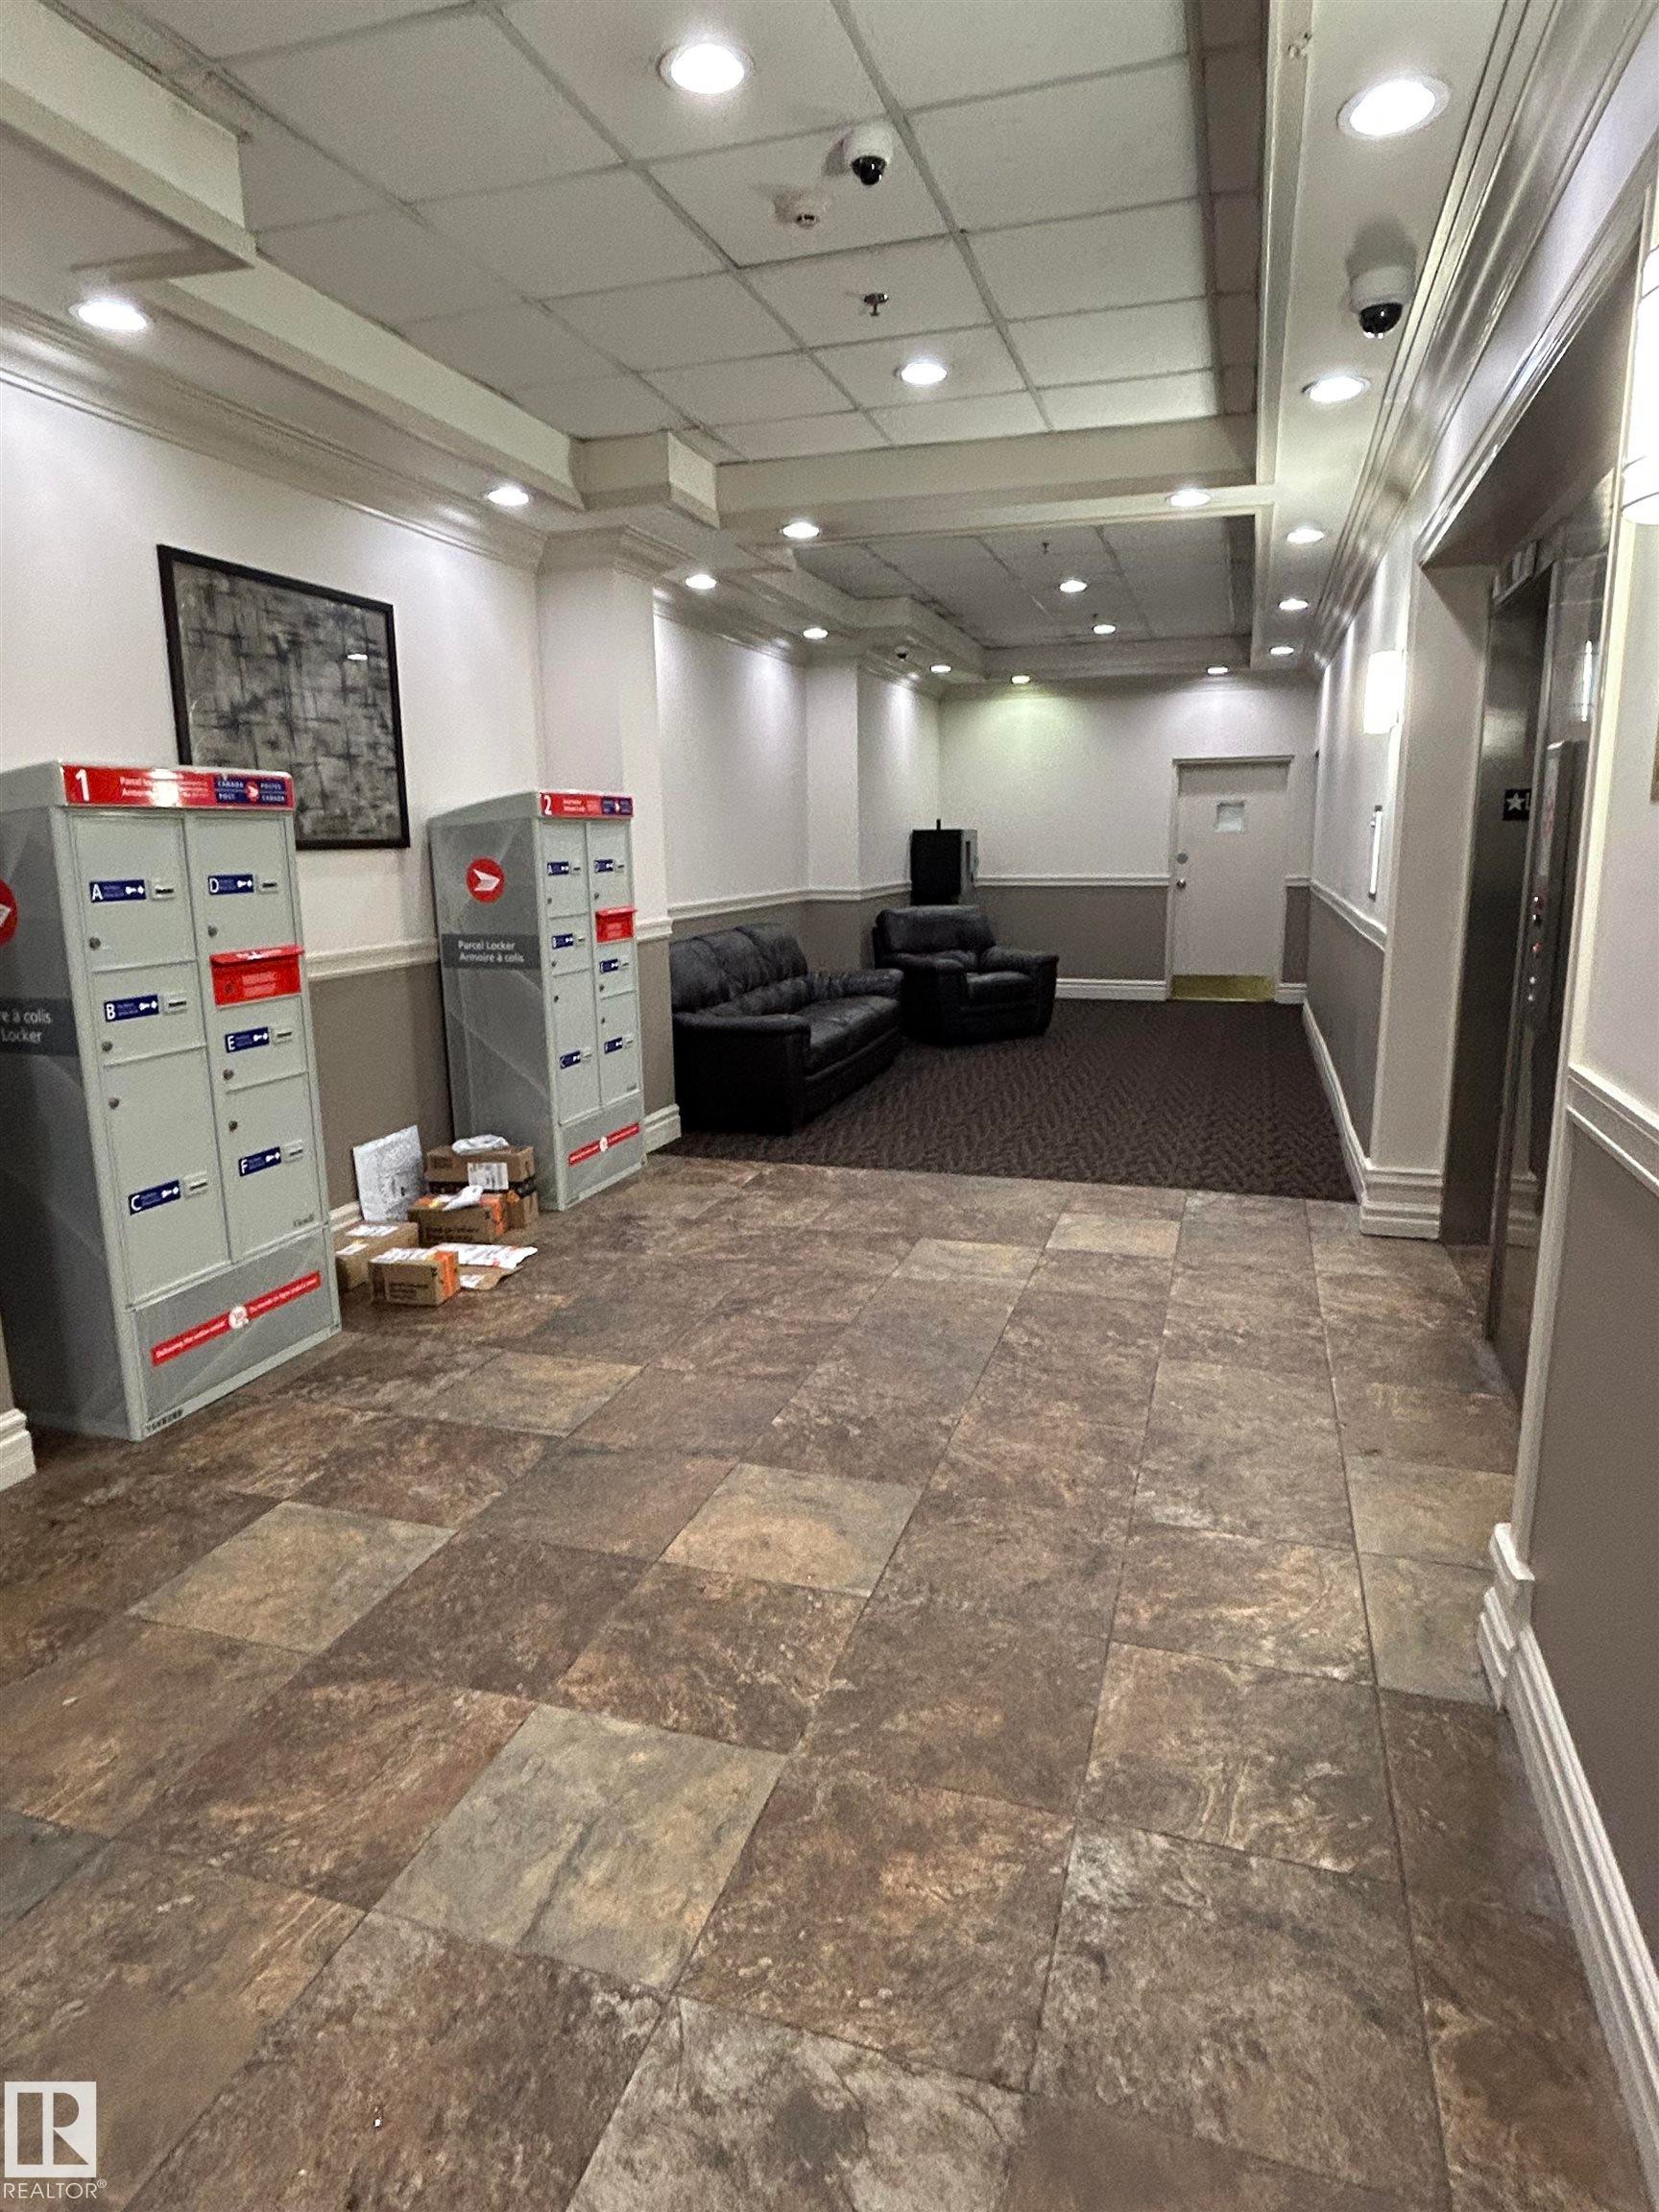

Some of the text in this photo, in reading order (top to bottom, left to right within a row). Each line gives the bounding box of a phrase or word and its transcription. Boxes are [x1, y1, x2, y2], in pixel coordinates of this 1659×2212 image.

[75, 768, 90, 802] 1
[543, 794, 553, 816] 2
[91, 884, 105, 901] A
[208, 878, 220, 894] D
[458, 940, 516, 950] Parcel Locker
[460, 951, 495, 962] Armoire
[23, 1008, 52, 1024] colis
[106, 1002, 116, 1020] B
[227, 1035, 236, 1051] E
[240, 1159, 249, 1175] F
[131, 1194, 142, 1212] C
